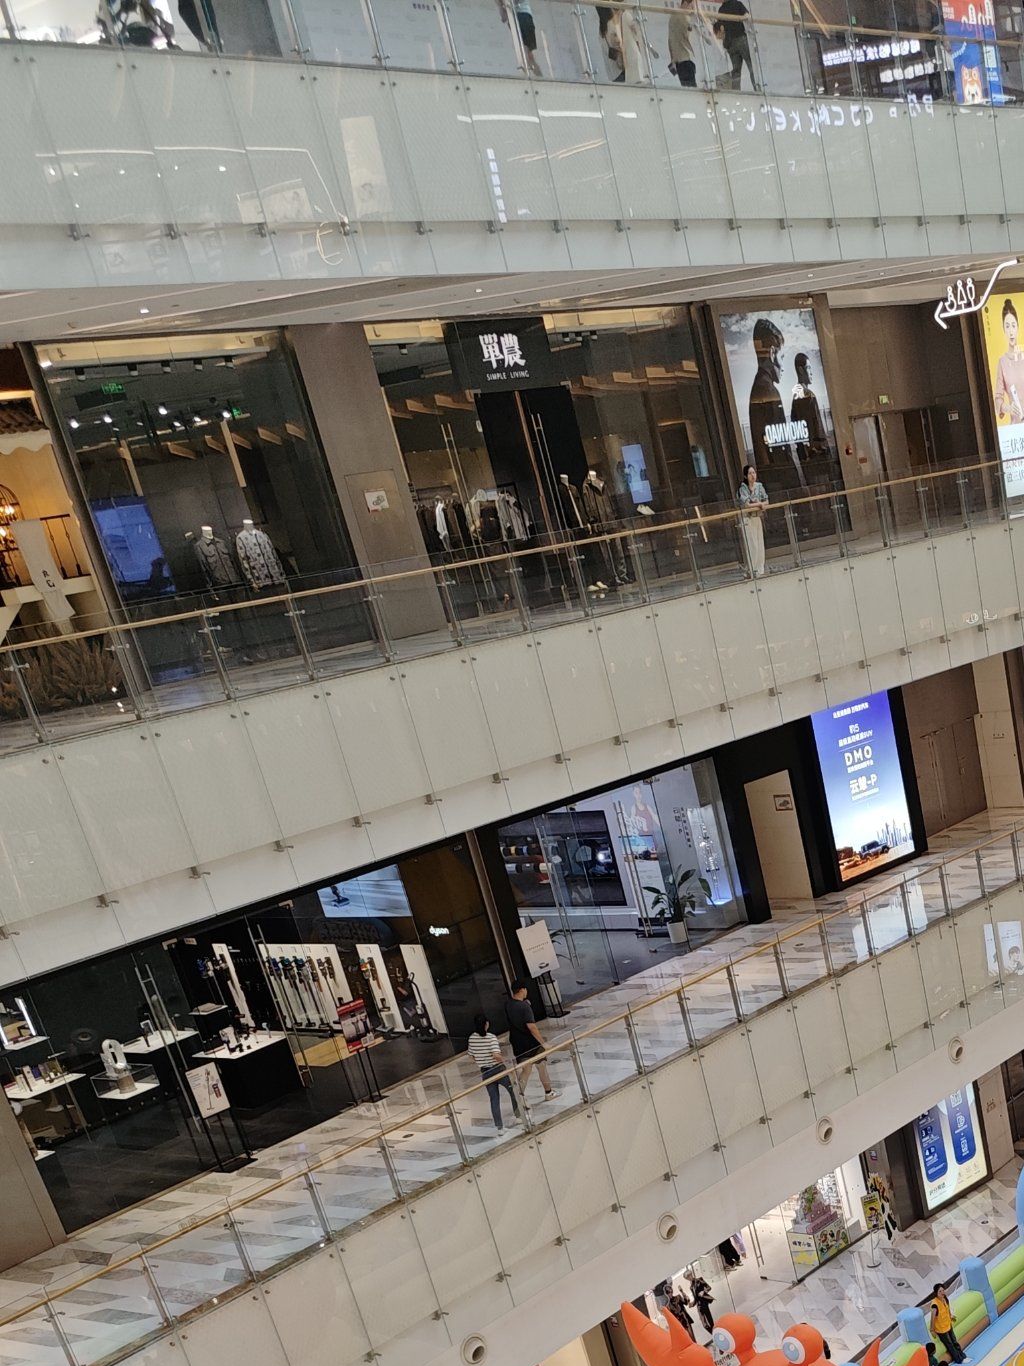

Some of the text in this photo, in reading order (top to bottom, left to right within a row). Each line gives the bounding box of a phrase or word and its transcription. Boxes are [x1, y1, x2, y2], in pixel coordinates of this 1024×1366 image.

[479, 332, 526, 370] 單農
[486, 370, 530, 381] SIMPLE LIVING
[844, 745, 872, 767] DMO
